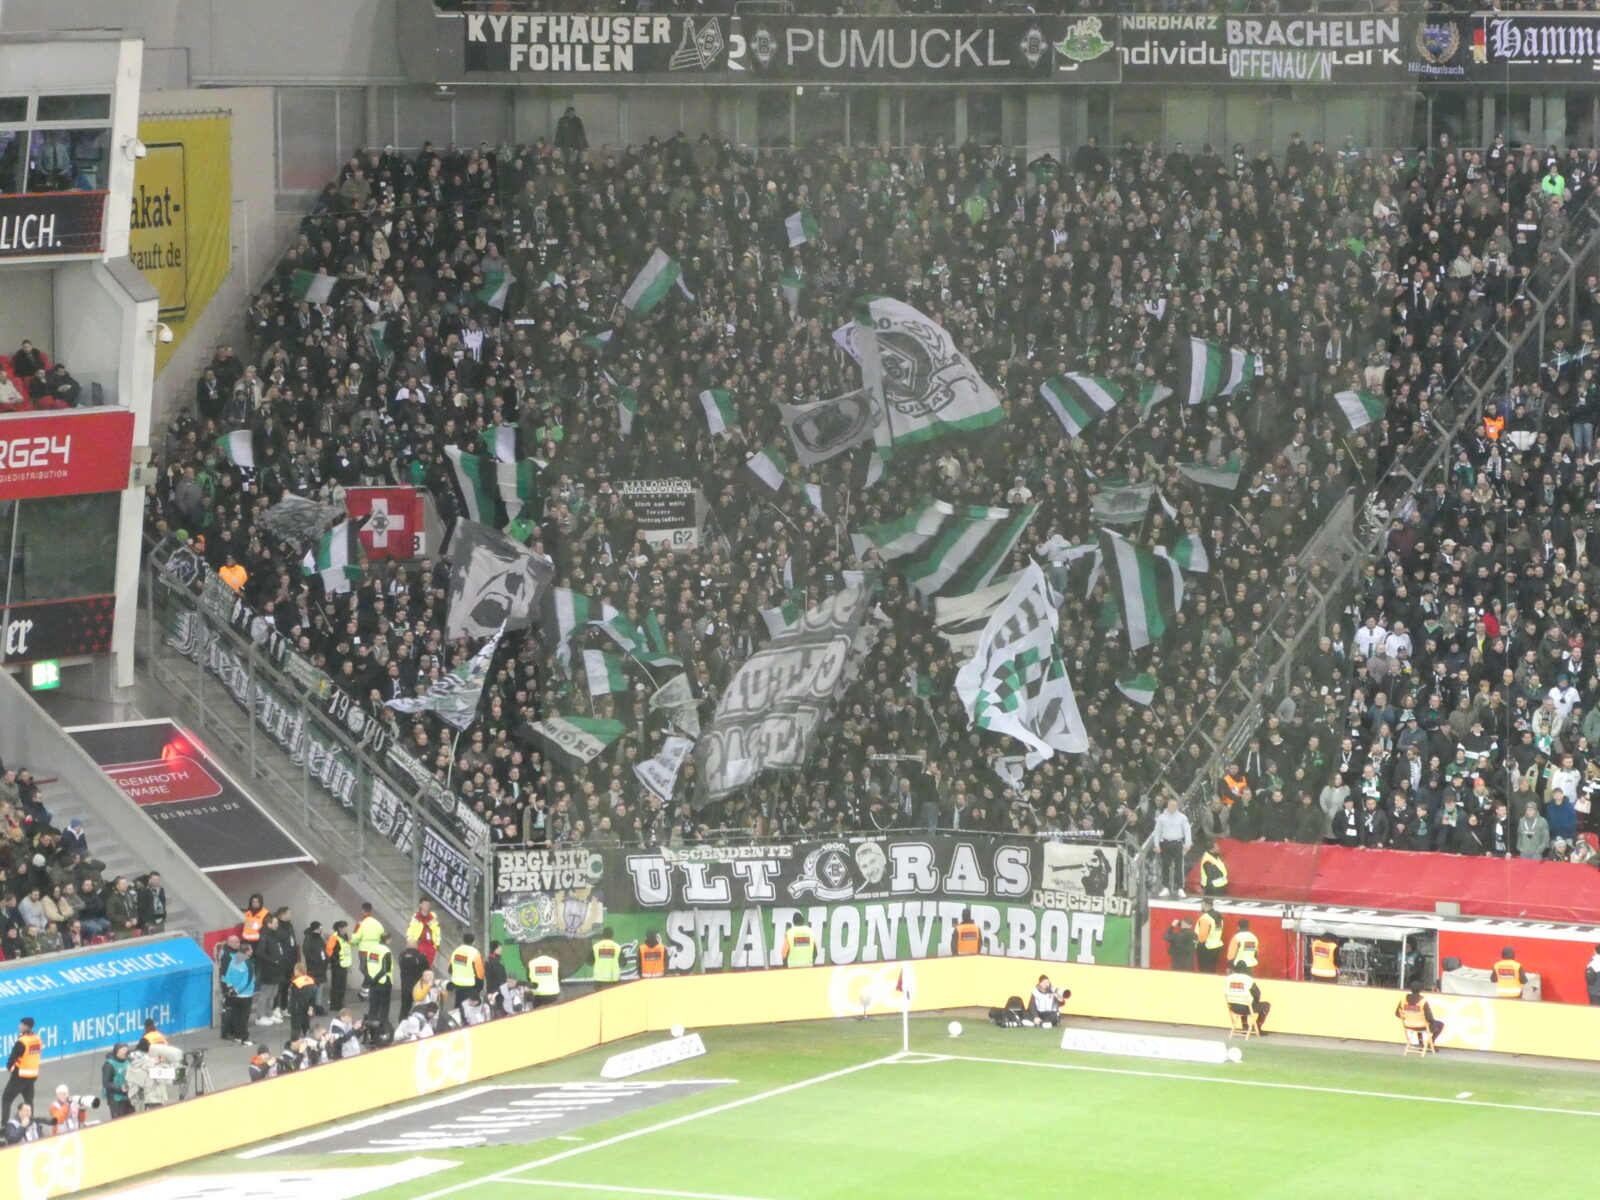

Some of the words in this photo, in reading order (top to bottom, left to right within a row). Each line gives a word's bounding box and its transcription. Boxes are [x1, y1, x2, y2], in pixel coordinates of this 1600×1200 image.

[467, 14, 671, 43] KYFFHÄUSER
[1122, 16, 1217, 30] NORDHARZ
[1226, 17, 1400, 46] BRACHELEN
[1489, 18, 1600, 58] Hamm
[510, 44, 634, 71] FOHLEN
[785, 28, 1011, 68] PUMUCKL
[1229, 50, 1332, 80] OFFENAU/N
[0, 213, 62, 250] LICH.
[328, 688, 350, 721] 19
[424, 833, 481, 888] RISPET
[498, 850, 590, 873] BEGLEIT
[661, 845, 793, 861] ASCENDENTE
[420, 851, 449, 883] PER
[451, 871, 471, 899] GL
[497, 869, 586, 892] SERVICE
[59, 952, 184, 985] MENSCHLICH.
